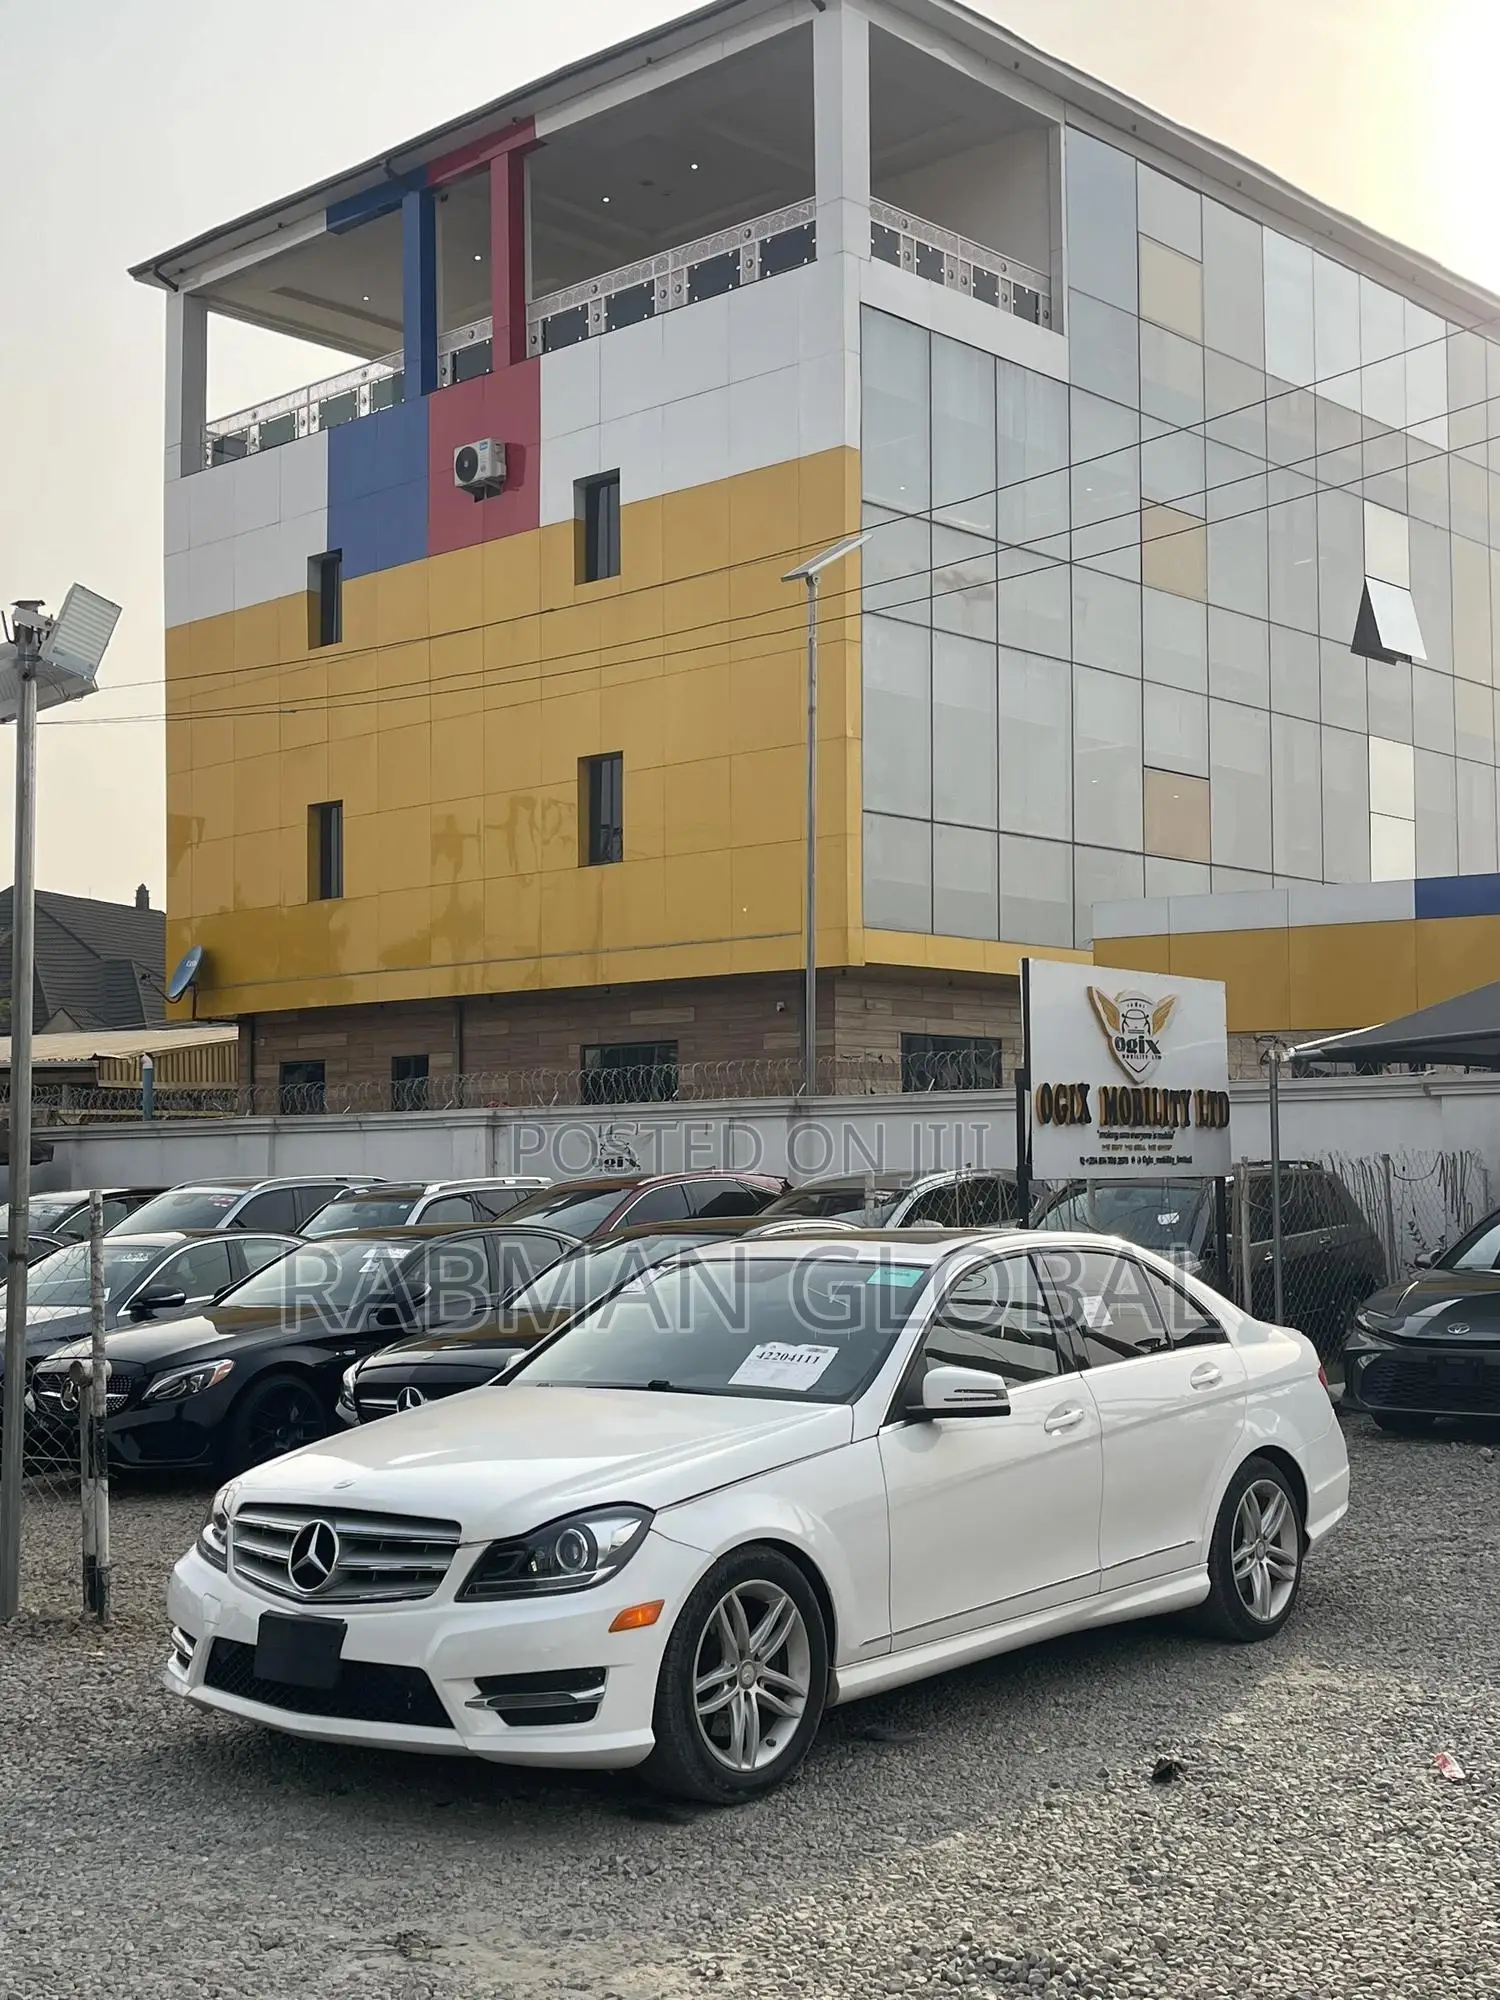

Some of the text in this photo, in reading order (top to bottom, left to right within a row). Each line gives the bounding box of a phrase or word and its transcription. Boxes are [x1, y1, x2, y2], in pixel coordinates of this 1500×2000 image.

[1036, 1082, 1230, 1129] OGIX MOBILITY LTD
